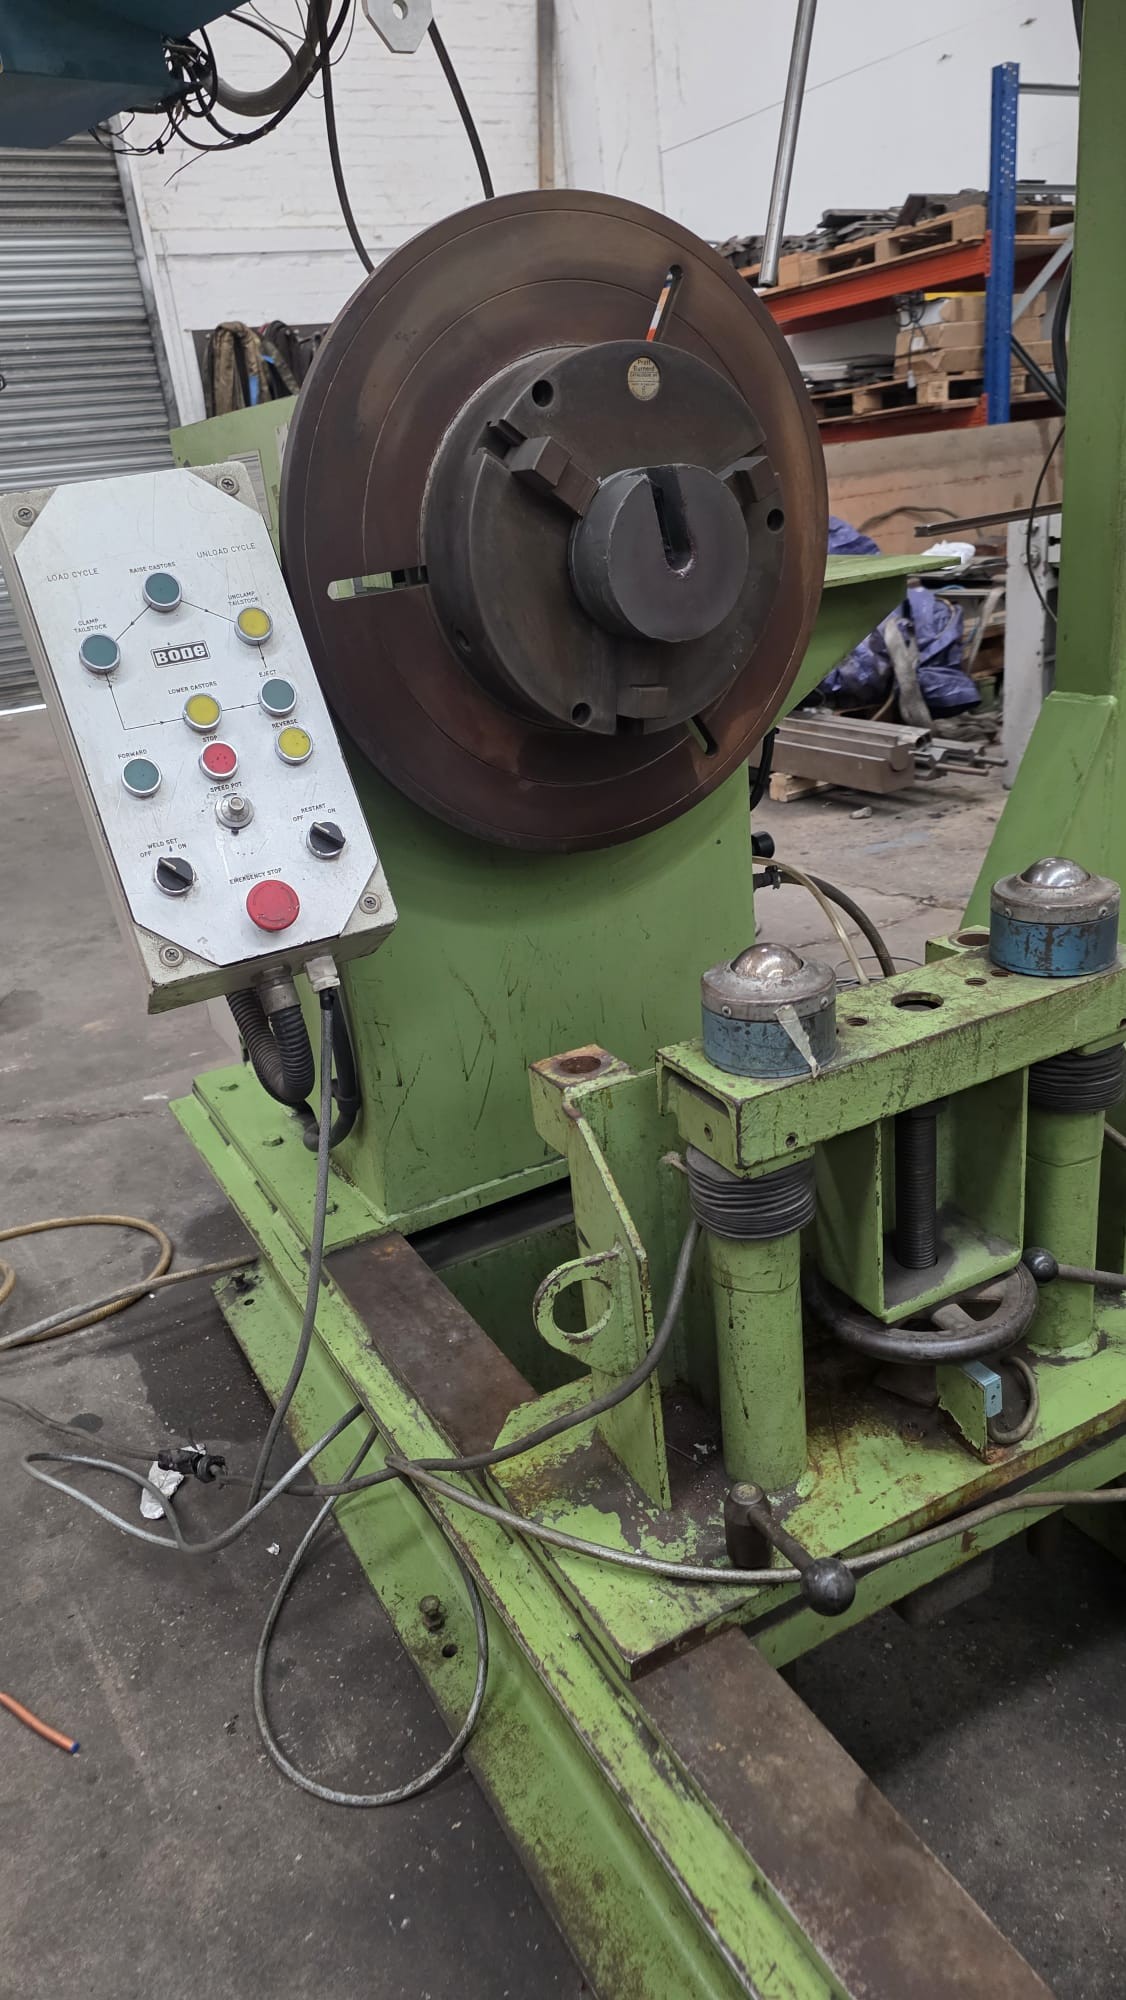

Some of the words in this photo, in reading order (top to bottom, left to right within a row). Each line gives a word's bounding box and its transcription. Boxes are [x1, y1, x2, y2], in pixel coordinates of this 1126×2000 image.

[196, 547, 228, 559] UNLOAD
[231, 543, 256, 553] CYCLE
[129, 565, 147, 574] RAISE
[148, 561, 176, 571] CASTORS
[47, 572, 69, 582] LOAD
[72, 568, 99, 578] CYCLE
[228, 590, 255, 600] UNCLAMP
[228, 597, 259, 606] TAILSTOCK
[78, 618, 99, 626] CLAMP
[73, 624, 107, 633] TAILSTOCK
[258, 669, 277, 678] EJECT
[168, 686, 188, 695] LOWER
[191, 680, 218, 691] CASTORS
[271, 718, 298, 729] REVERSE
[202, 735, 218, 743] STOP
[118, 748, 147, 760] FORWARD
[210, 783, 229, 793] SPEED
[230, 781, 242, 790] POT
[300, 803, 326, 814] RESTART
[147, 841, 164, 850] WELD
[165, 838, 178, 846] SET
[140, 850, 152, 858] OFF
[229, 871, 266, 885] EMERGENCY
[267, 867, 282, 876] STOP
